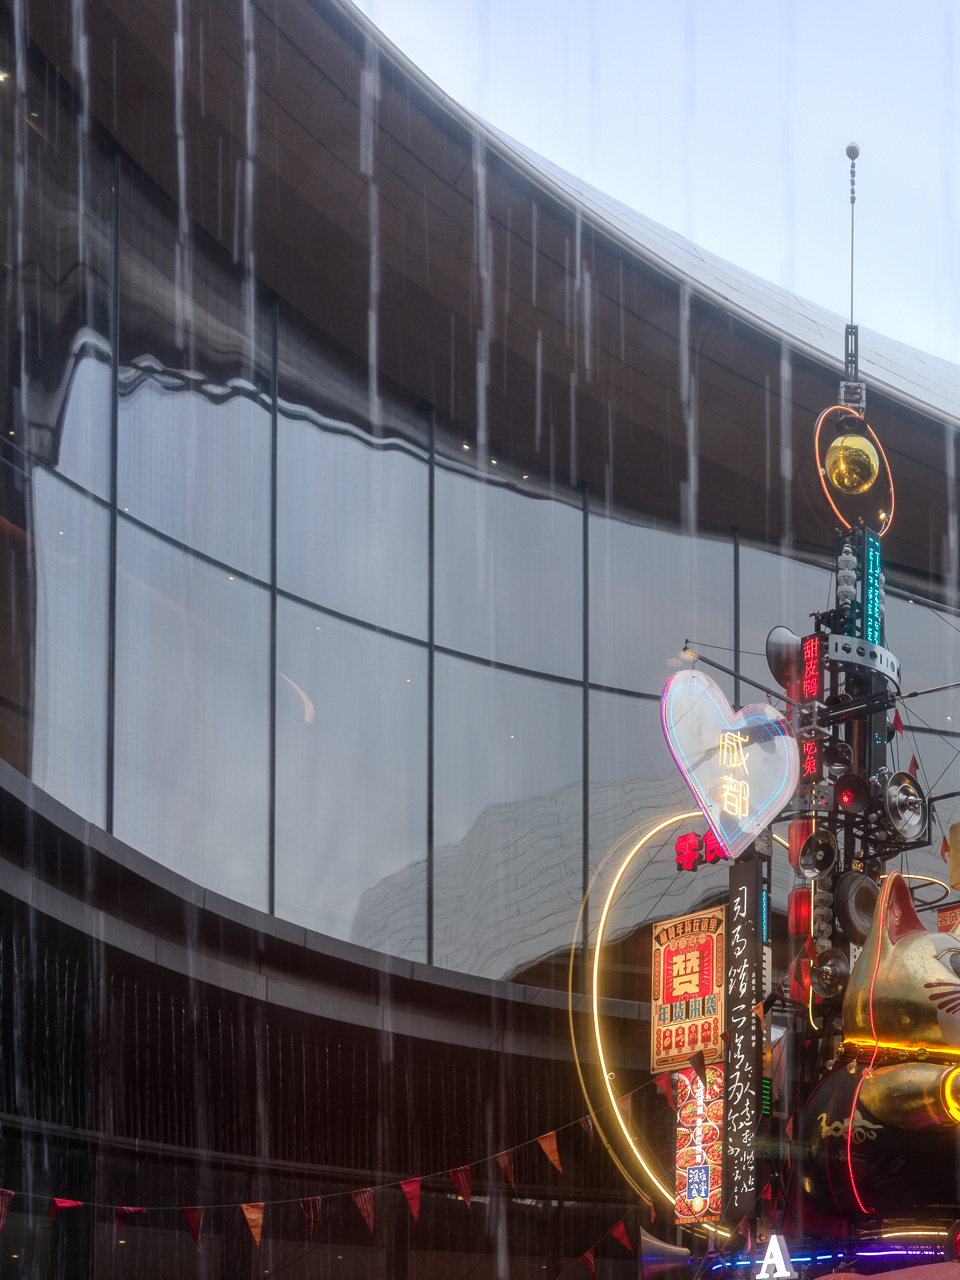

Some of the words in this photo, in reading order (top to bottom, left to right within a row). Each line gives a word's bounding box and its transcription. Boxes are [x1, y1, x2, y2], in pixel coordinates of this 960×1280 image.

[803, 637, 819, 699] 甜皮鸭
[719, 731, 750, 820] 成都
[802, 741, 818, 777] 吃兔
[675, 829, 725, 870] 零食
[672, 950, 701, 997] 赞
[658, 994, 718, 1025] 年货来袭
[756, 1234, 795, 1280] A
